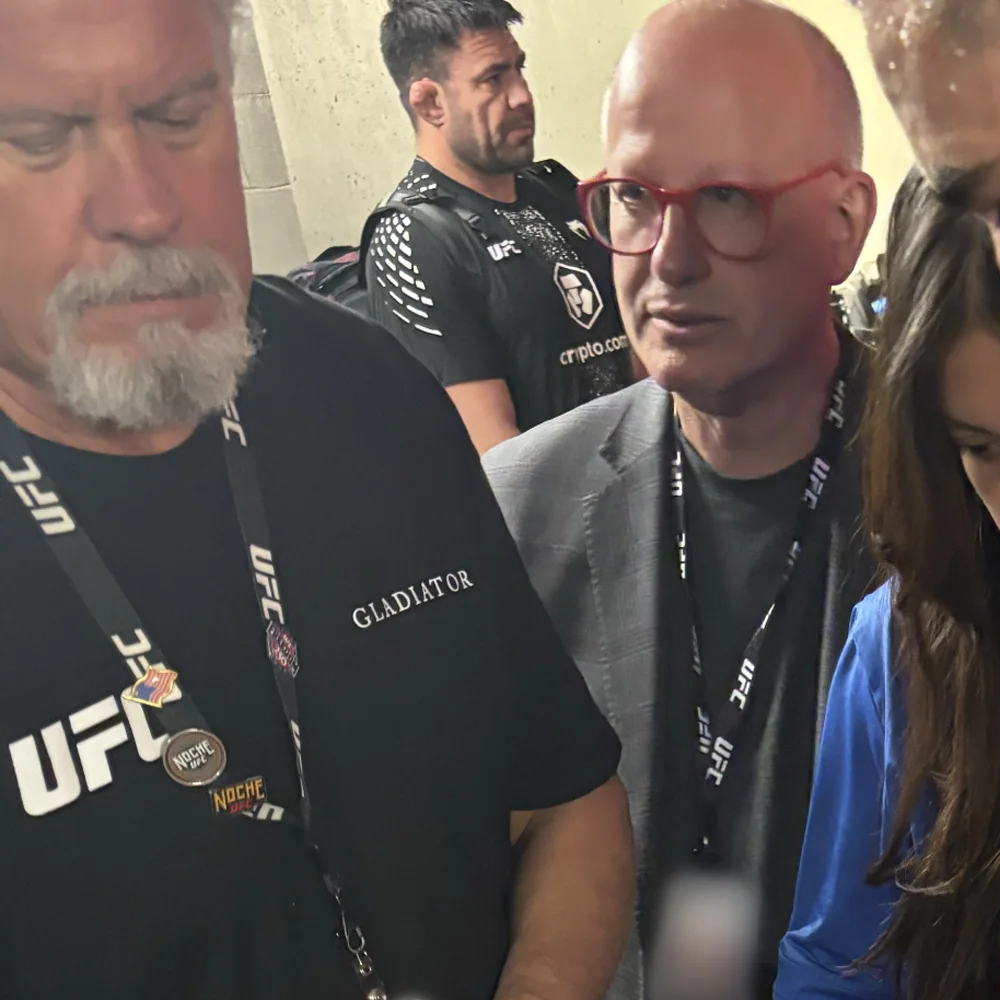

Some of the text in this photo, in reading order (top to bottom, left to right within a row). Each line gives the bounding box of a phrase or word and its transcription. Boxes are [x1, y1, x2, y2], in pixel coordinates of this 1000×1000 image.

[486, 239, 522, 261] UFC
[0, 455, 76, 535] UFC
[803, 456, 830, 510] UFC
[249, 543, 284, 625] UFC
[352, 569, 475, 629] GLADIATOR
[729, 658, 755, 710] UFC
[172, 739, 215, 772] NOCHE
[706, 735, 734, 786] UFC
[213, 778, 266, 812] NOCHE
